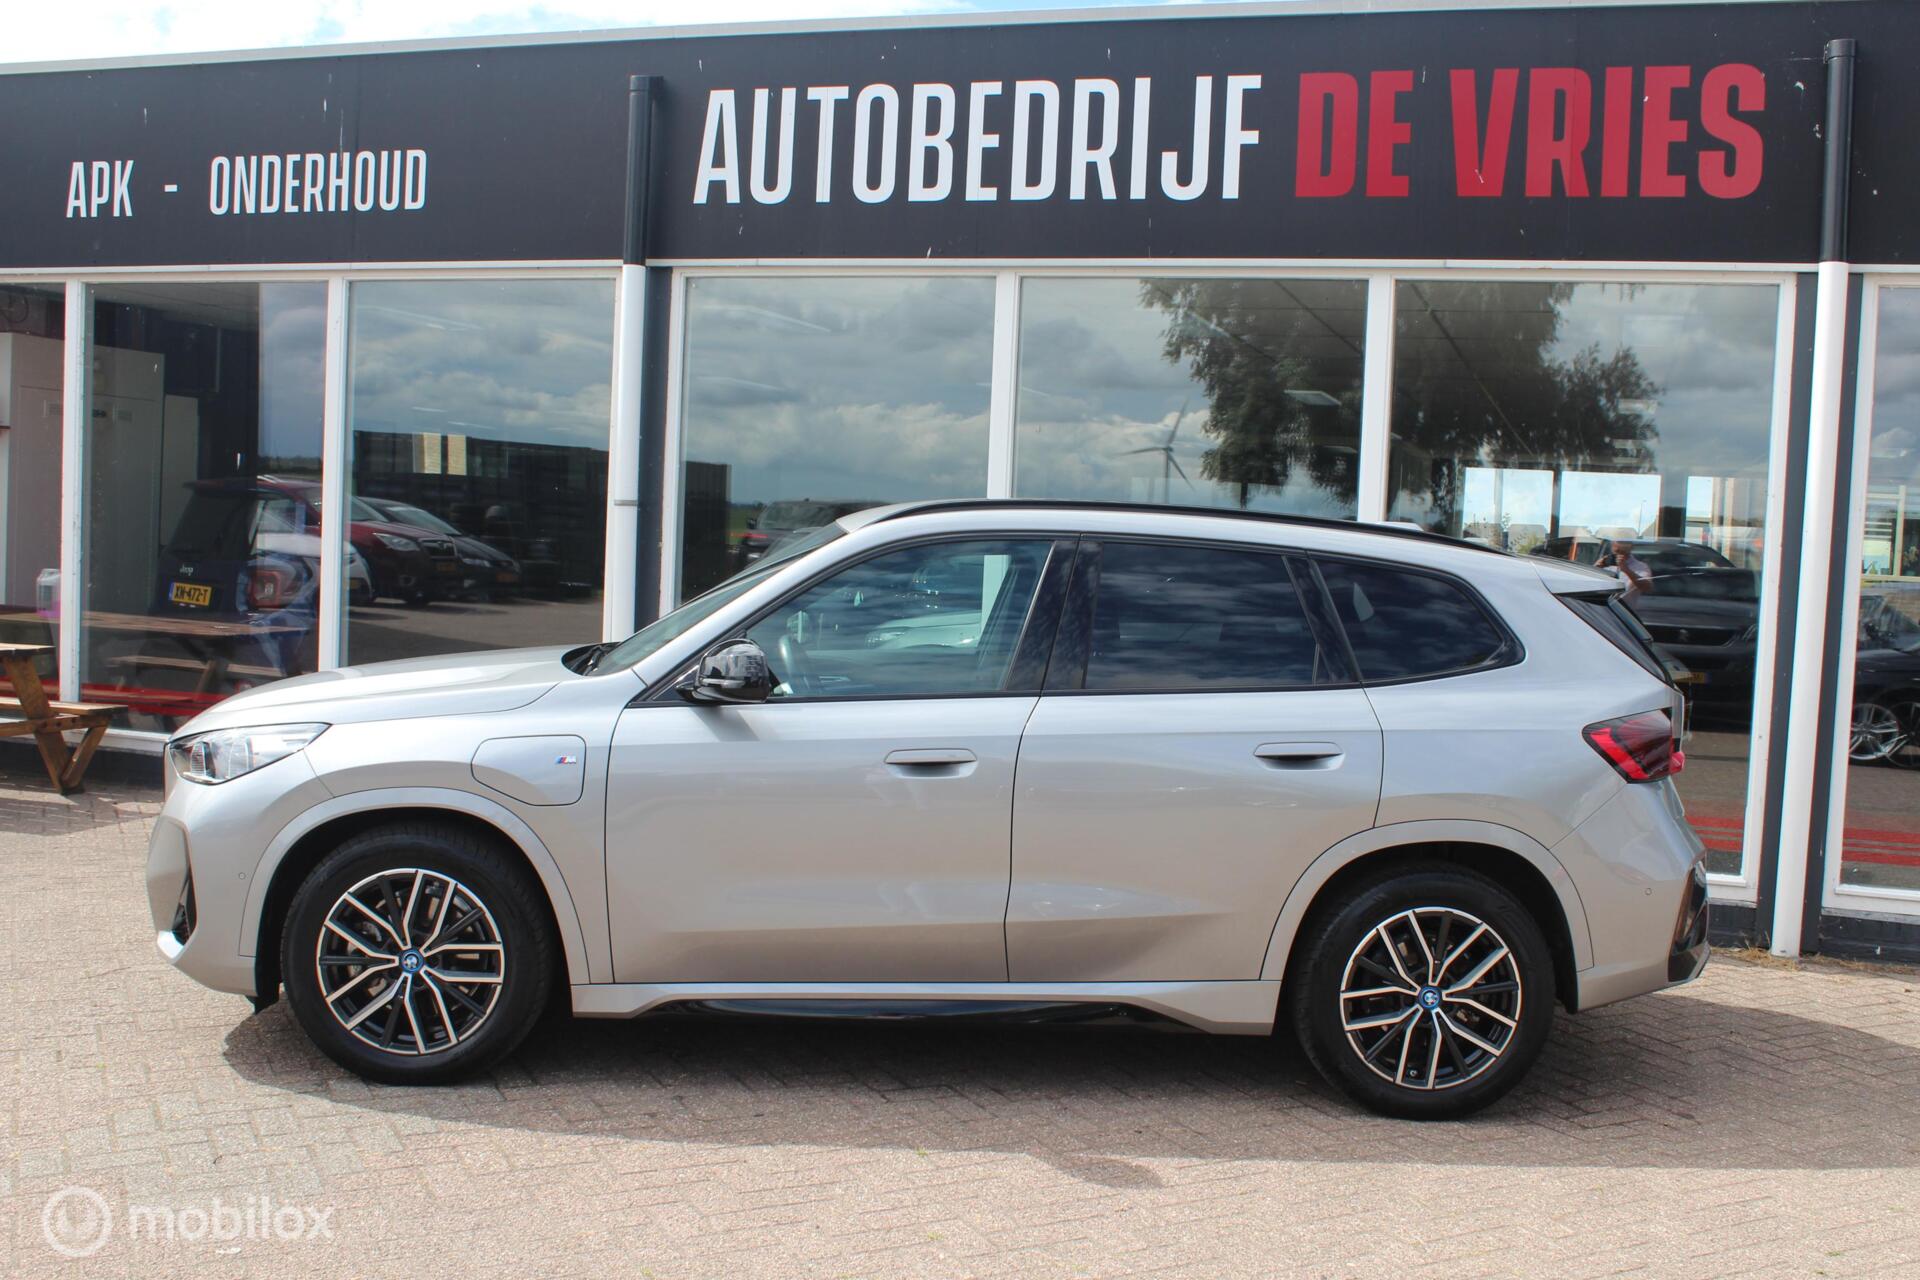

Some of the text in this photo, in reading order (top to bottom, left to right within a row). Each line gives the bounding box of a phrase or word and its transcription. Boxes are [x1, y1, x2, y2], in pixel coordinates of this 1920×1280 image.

[65, 159, 134, 218] APK
[209, 149, 427, 215] ONDERHOUD
[692, 63, 1766, 205] AUTOBEDRIJF DE VRIES
